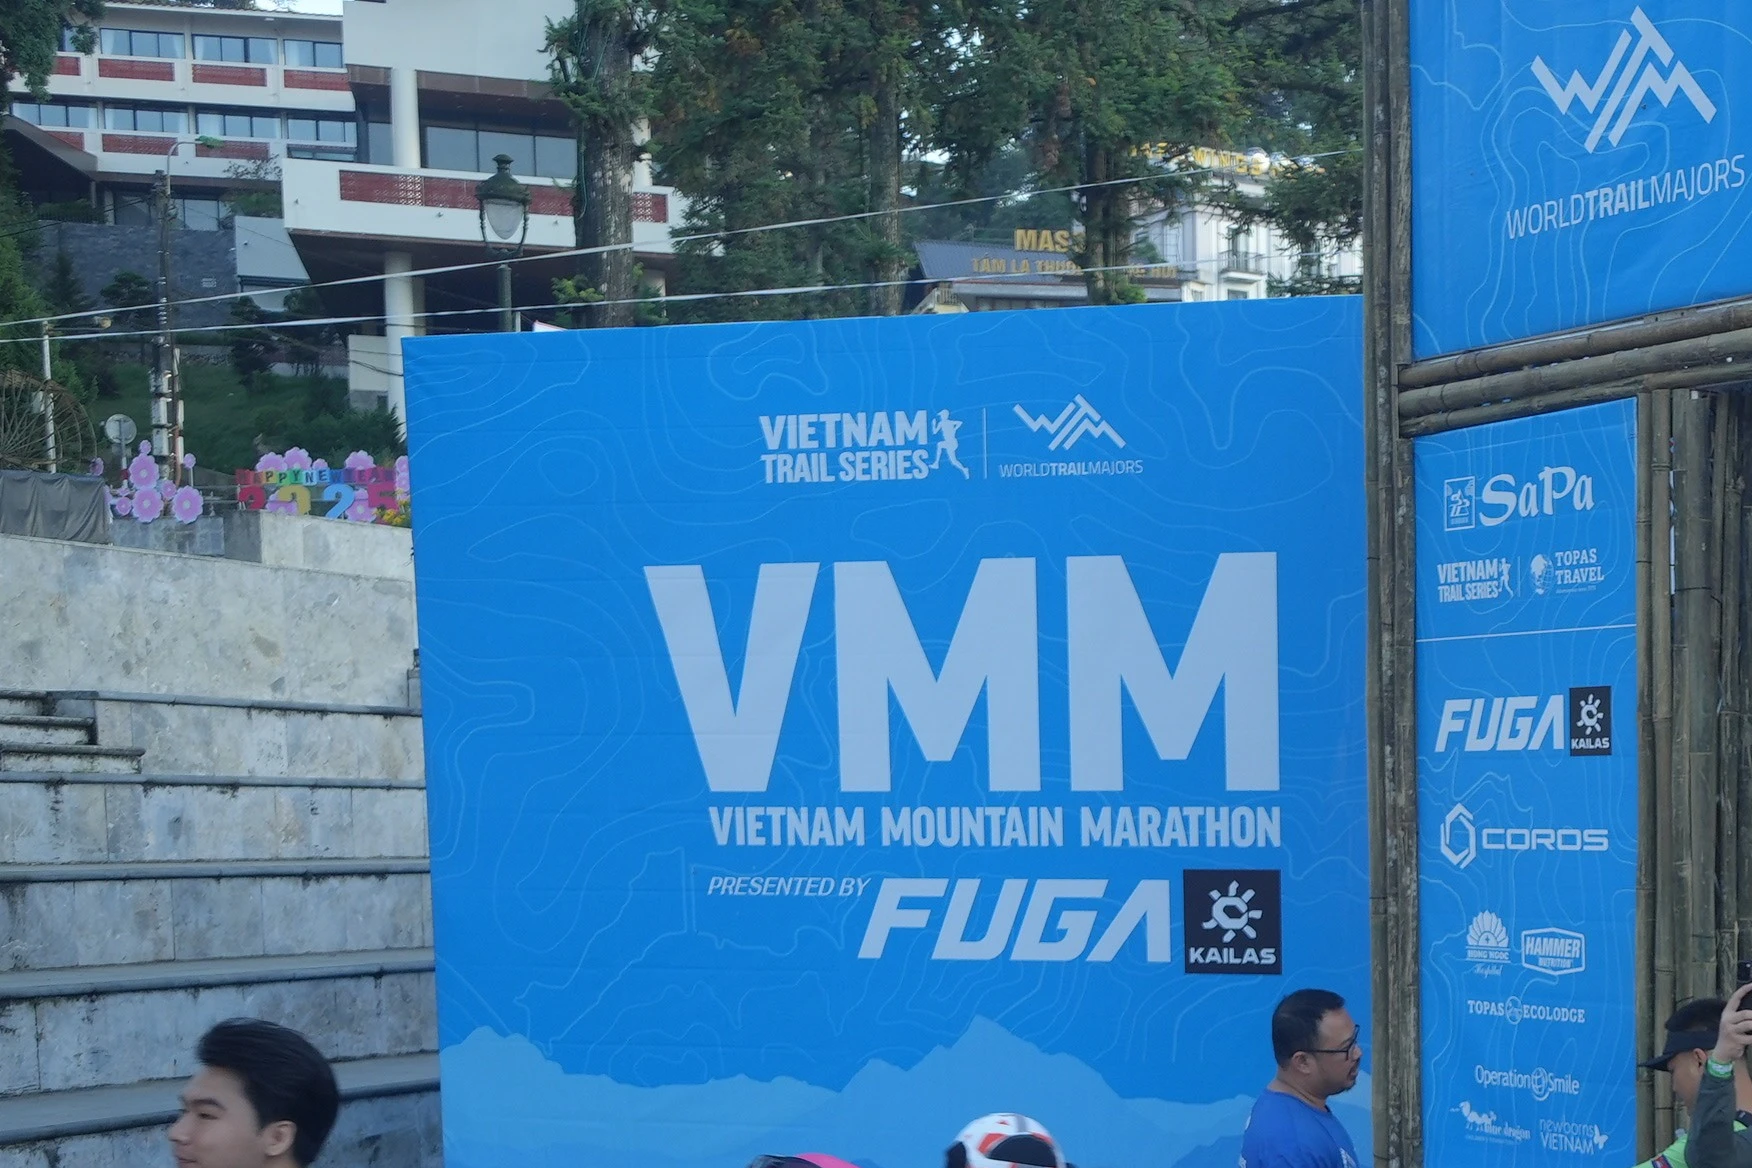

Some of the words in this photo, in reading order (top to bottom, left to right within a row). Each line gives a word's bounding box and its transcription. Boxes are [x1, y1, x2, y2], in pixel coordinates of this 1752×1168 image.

[758, 409, 928, 451] VIETNAM
[761, 452, 835, 485] TRAIL
[838, 449, 930, 482] SERIES
[1478, 465, 1596, 527] SaPa
[1555, 548, 1598, 565] TOPAS
[1437, 557, 1499, 584] VIETNAM
[1555, 565, 1605, 585] TRAVEL
[1438, 585, 1465, 603] TRAIL
[1465, 582, 1499, 601] SERIES
[644, 551, 1280, 792] VMM
[1434, 694, 1565, 753] FUGA
[1570, 737, 1610, 750] KAILAS
[709, 805, 866, 848] VIETNAM
[881, 805, 1065, 848] MOUNTAIN
[1079, 804, 1281, 848] MARATHON
[1481, 828, 1609, 851] COROS
[708, 875, 835, 898] PRESENTED
[840, 876, 872, 898] BY
[857, 877, 1172, 963] FUGA
[1188, 945, 1277, 966] KAILAS
[1525, 935, 1582, 959] HAMMER
[1467, 1000, 1505, 1016] TOPAS
[1522, 1003, 1586, 1024] ECOLODGE
[1474, 1064, 1532, 1089] Operation
[1548, 1071, 1580, 1095] Smile
[1539, 1118, 1595, 1136] newborns
[1540, 1134, 1595, 1155] VIETNAM
